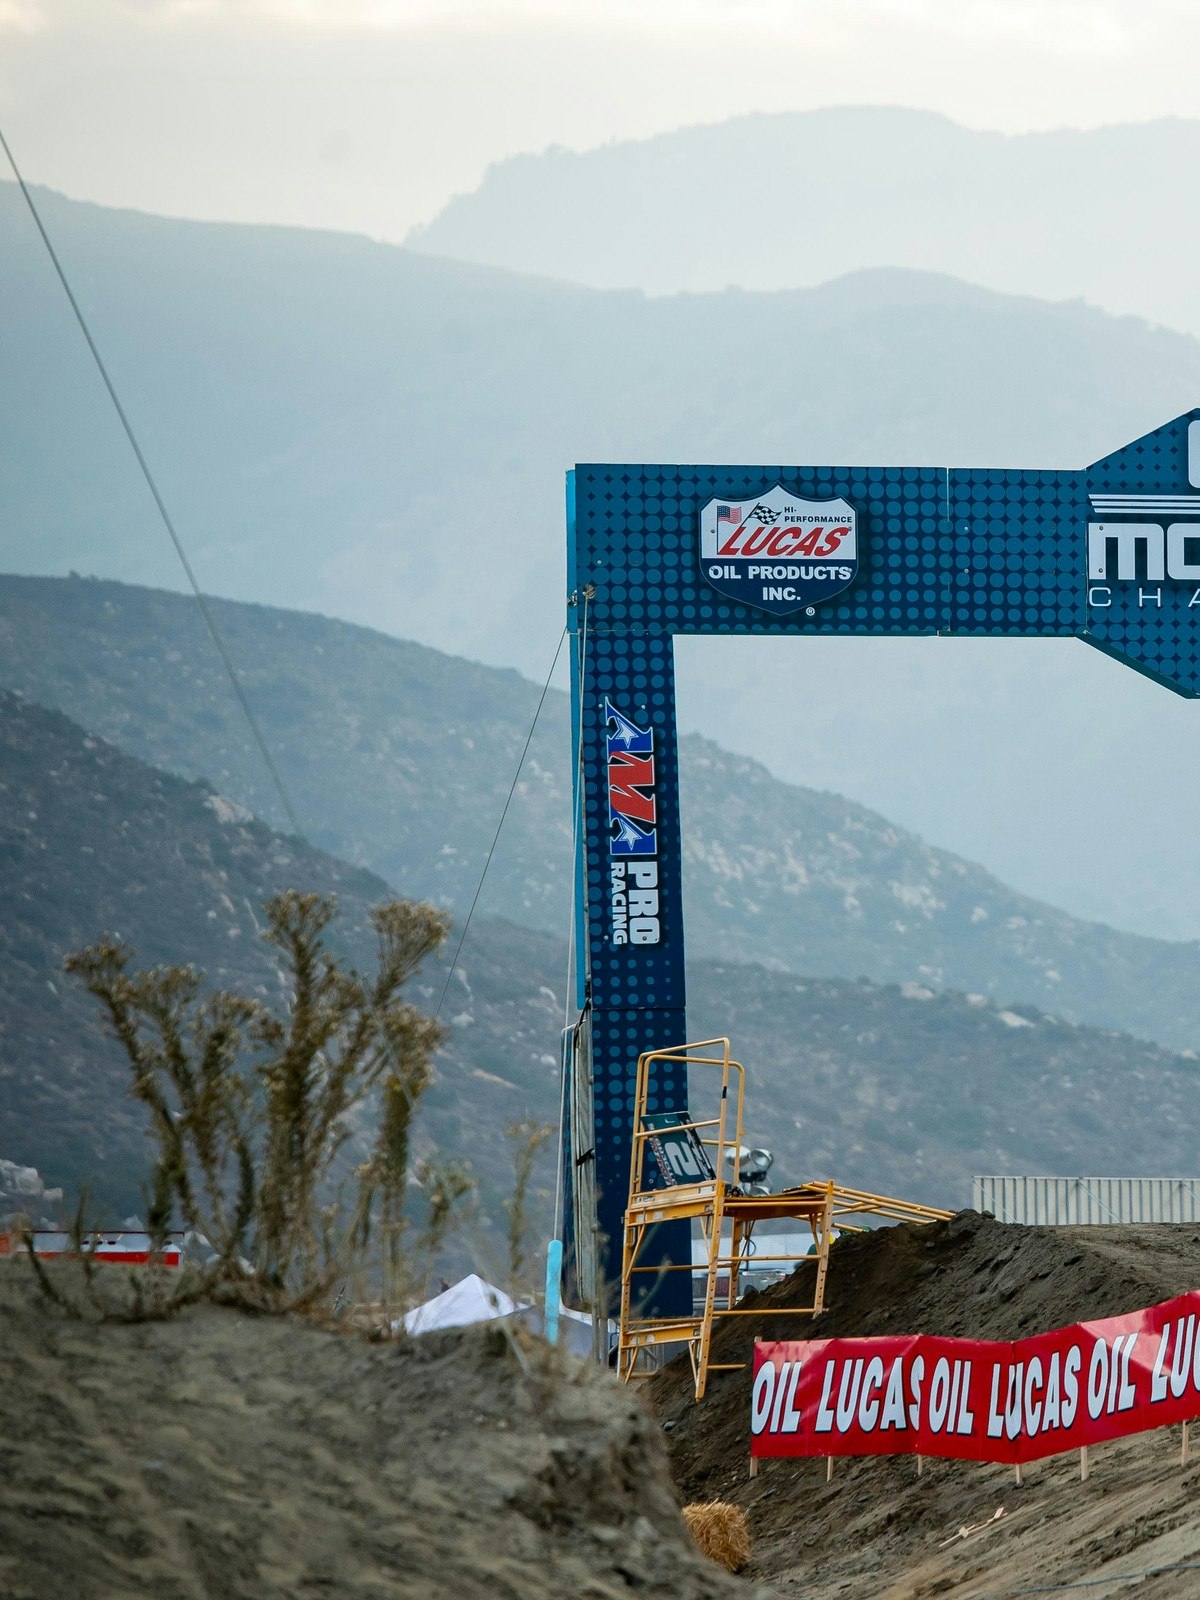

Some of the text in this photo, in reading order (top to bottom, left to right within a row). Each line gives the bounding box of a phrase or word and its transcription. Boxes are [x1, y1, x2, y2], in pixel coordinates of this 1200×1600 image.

[784, 506, 797, 514] HI-
[717, 526, 850, 557] LUCAS
[708, 565, 852, 580] OIL PRODUCTS
[762, 586, 801, 601] INC.
[605, 696, 657, 856] AMA
[610, 862, 628, 945] RACING
[627, 861, 660, 945] PRO
[751, 1359, 803, 1435] OIL
[815, 1355, 925, 1434] LUCAS
[927, 1356, 975, 1437] OIL
[987, 1344, 1082, 1441] LUCAS
[1087, 1331, 1139, 1420] OIL
